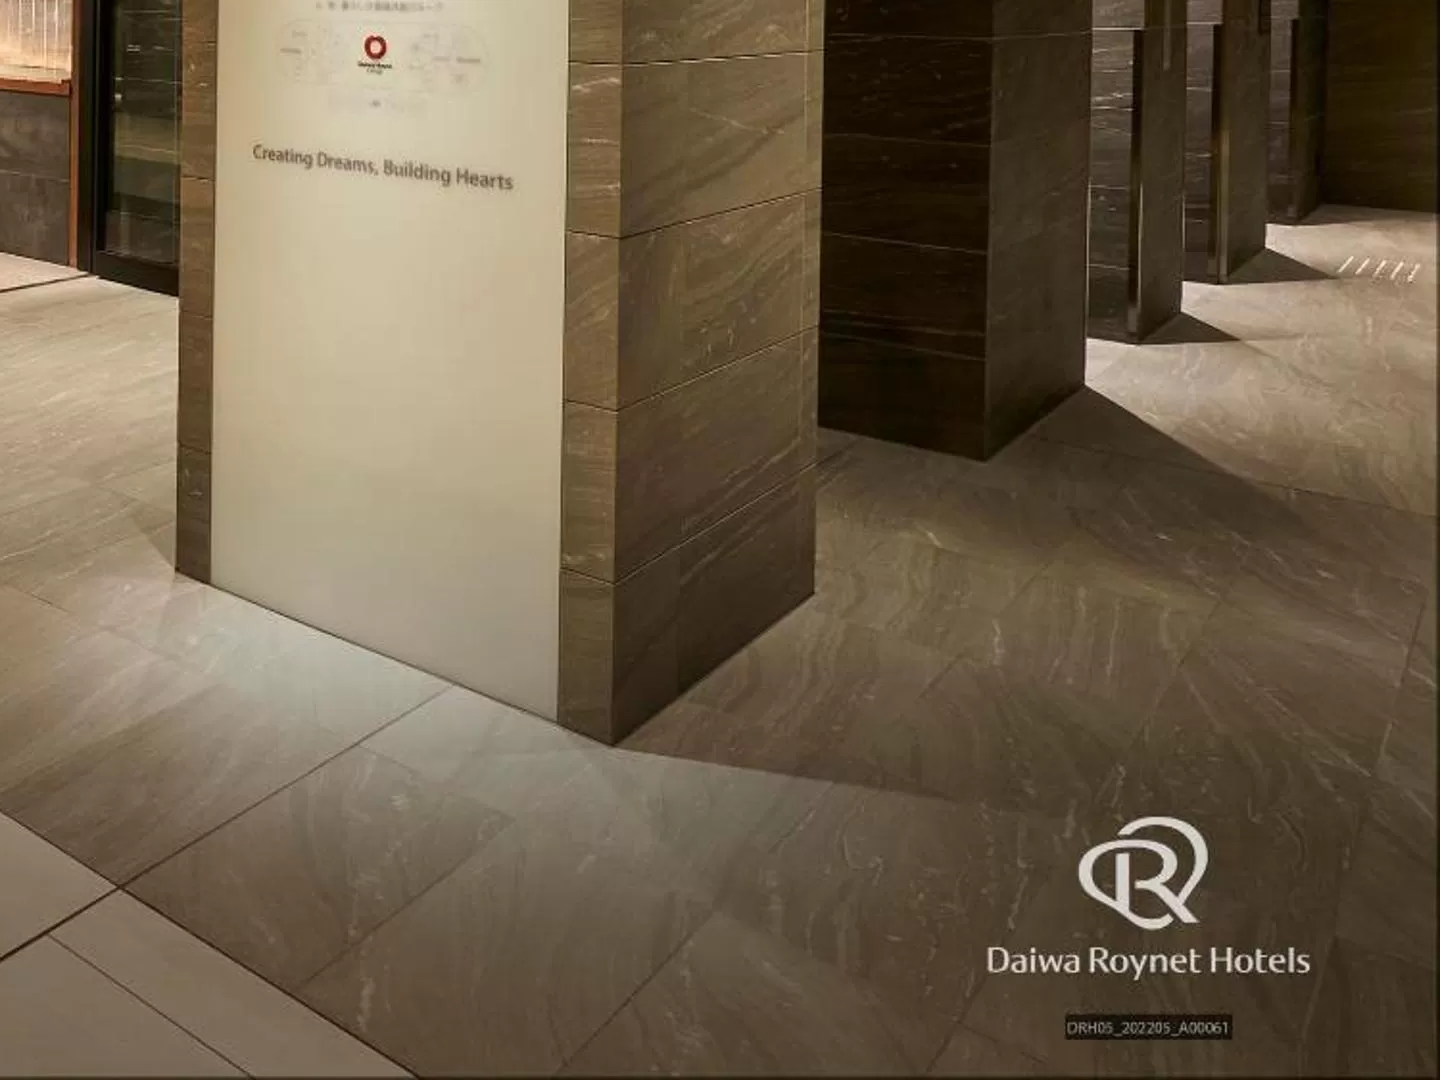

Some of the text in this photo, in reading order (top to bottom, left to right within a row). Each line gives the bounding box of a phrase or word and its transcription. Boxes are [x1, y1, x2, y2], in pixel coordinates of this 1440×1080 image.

[252, 143, 514, 190] Creating Dreams, Building Hearts
